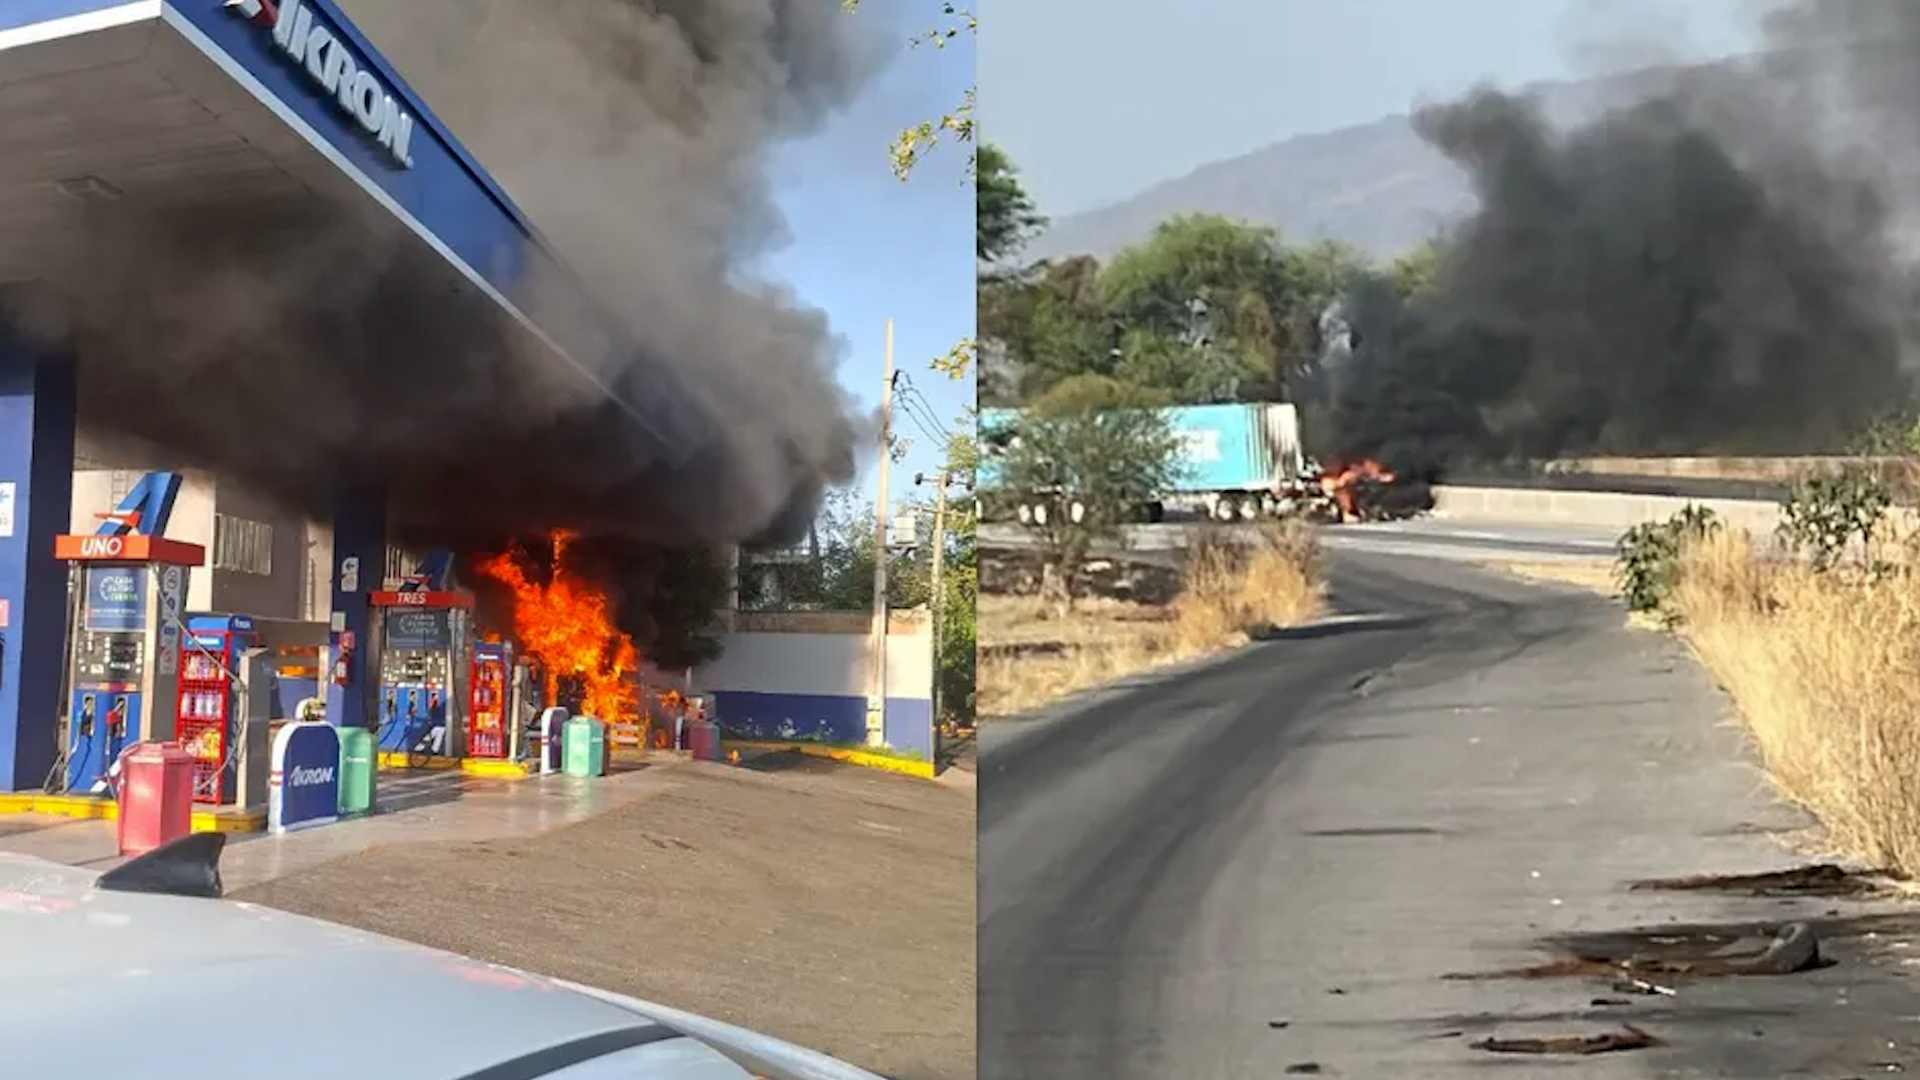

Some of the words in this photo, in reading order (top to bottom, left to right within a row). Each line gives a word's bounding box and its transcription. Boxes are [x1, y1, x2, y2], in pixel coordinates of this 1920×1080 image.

[81, 537, 123, 556] UNO
[397, 592, 427, 605] TRES
[288, 765, 333, 787] AKRON
